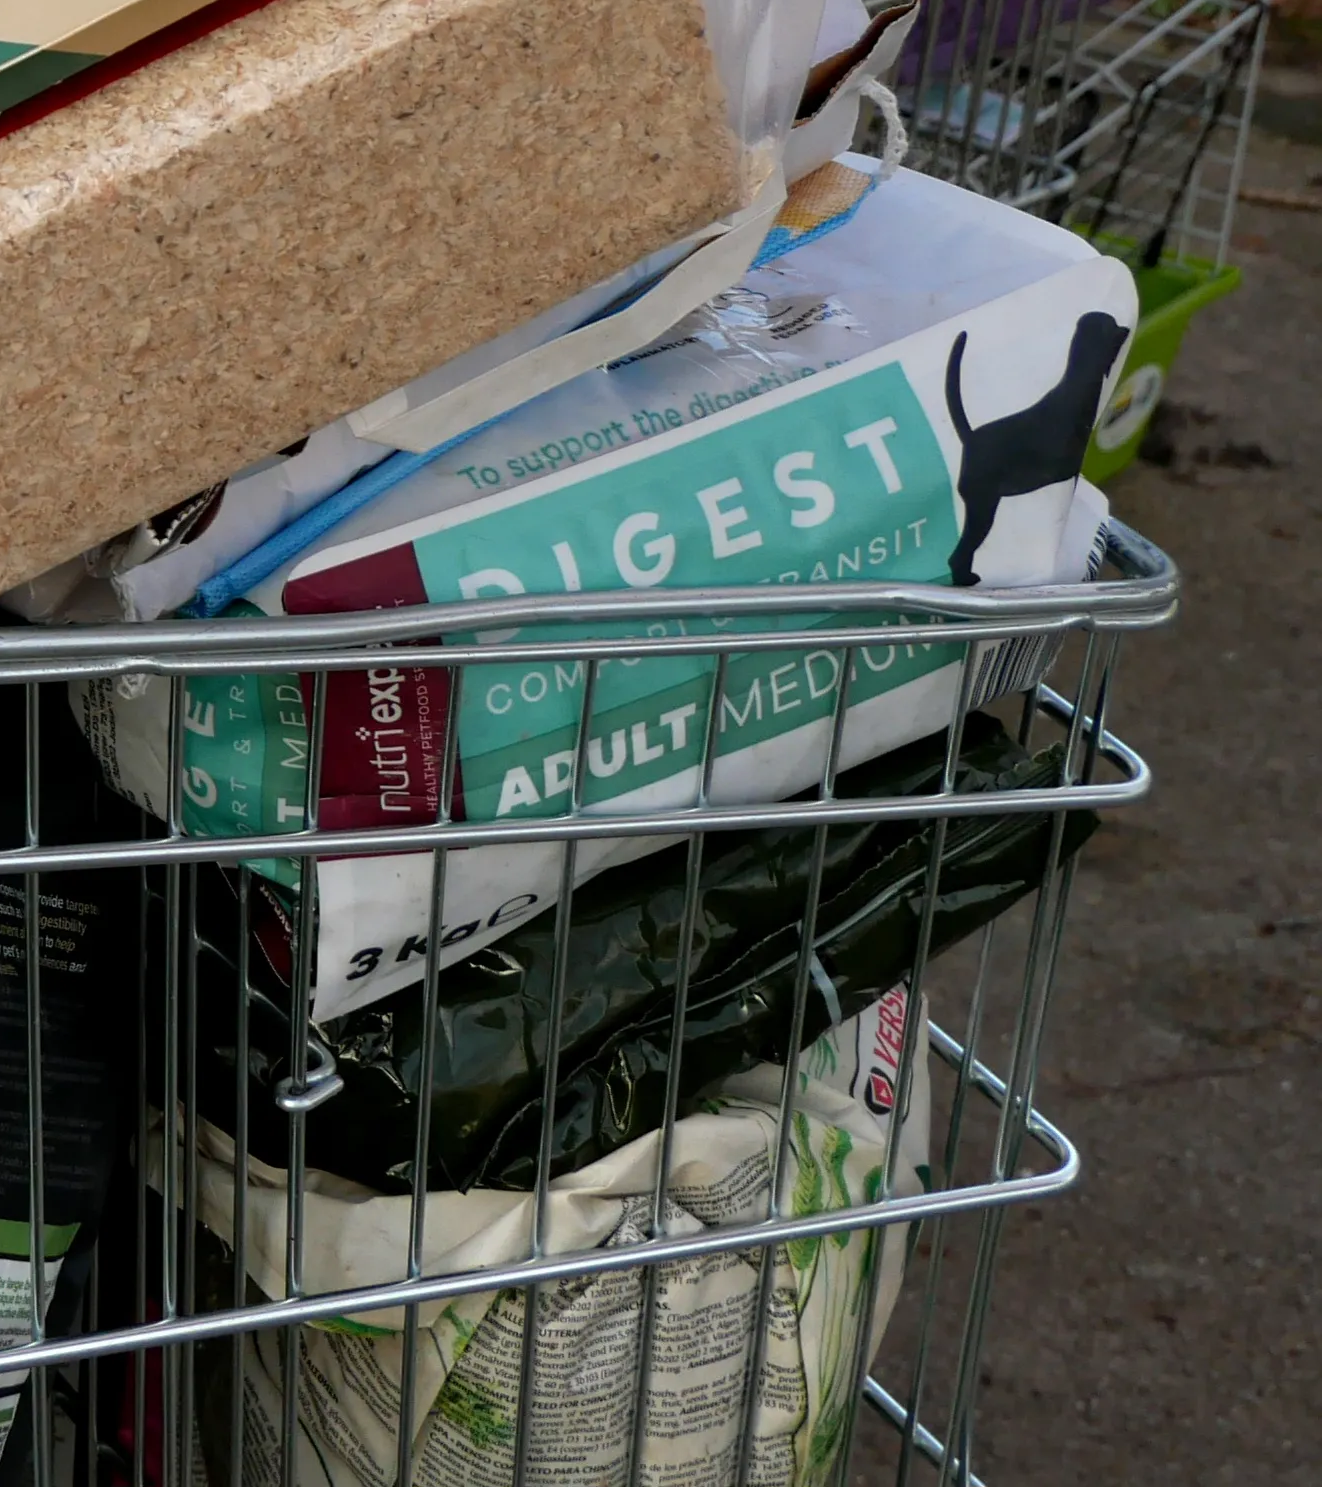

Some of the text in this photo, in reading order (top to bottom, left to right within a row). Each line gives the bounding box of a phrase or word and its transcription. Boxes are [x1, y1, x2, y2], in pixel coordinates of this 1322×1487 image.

[457, 466, 501, 490] To
[507, 421, 631, 480] support
[634, 404, 683, 437] the
[458, 416, 905, 644] DIGEST
[416, 678, 437, 812] HEALTHY PETFOOD
[495, 703, 697, 816] ADULT
[346, 946, 384, 981] 3
[531, 1383, 632, 1411] FEED FOR CHINCHILLAS
[432, 1421, 490, 1456] SPA PIENSO
[527, 1452, 587, 1464] Antioxidants
